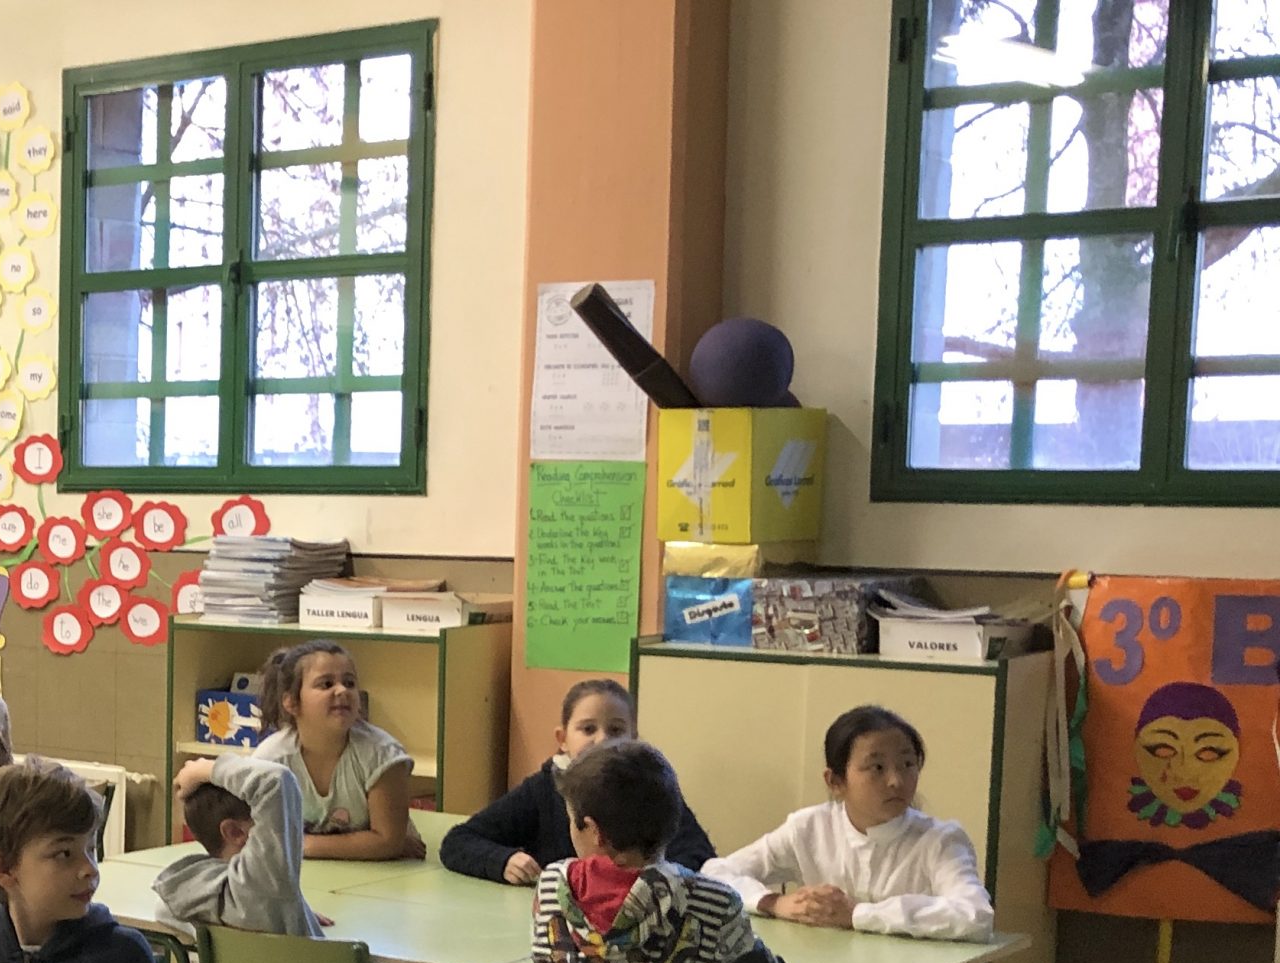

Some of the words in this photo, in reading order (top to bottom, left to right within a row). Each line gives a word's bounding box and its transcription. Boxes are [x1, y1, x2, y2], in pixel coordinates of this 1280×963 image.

[27, 208, 48, 219] here
[32, 307, 42, 315] so
[30, 372, 43, 384] my
[35, 447, 44, 470] I
[97, 508, 113, 520] she
[153, 516, 164, 533] be
[228, 514, 243, 530] all
[118, 554, 130, 571] he
[26, 573, 40, 591] do
[306, 608, 335, 618] TALLER
[337, 610, 369, 619] LENGUA
[406, 613, 440, 623] LENGUA
[60, 618, 71, 639] to
[908, 640, 958, 651] VALORES
[1211, 594, 1280, 685] B
